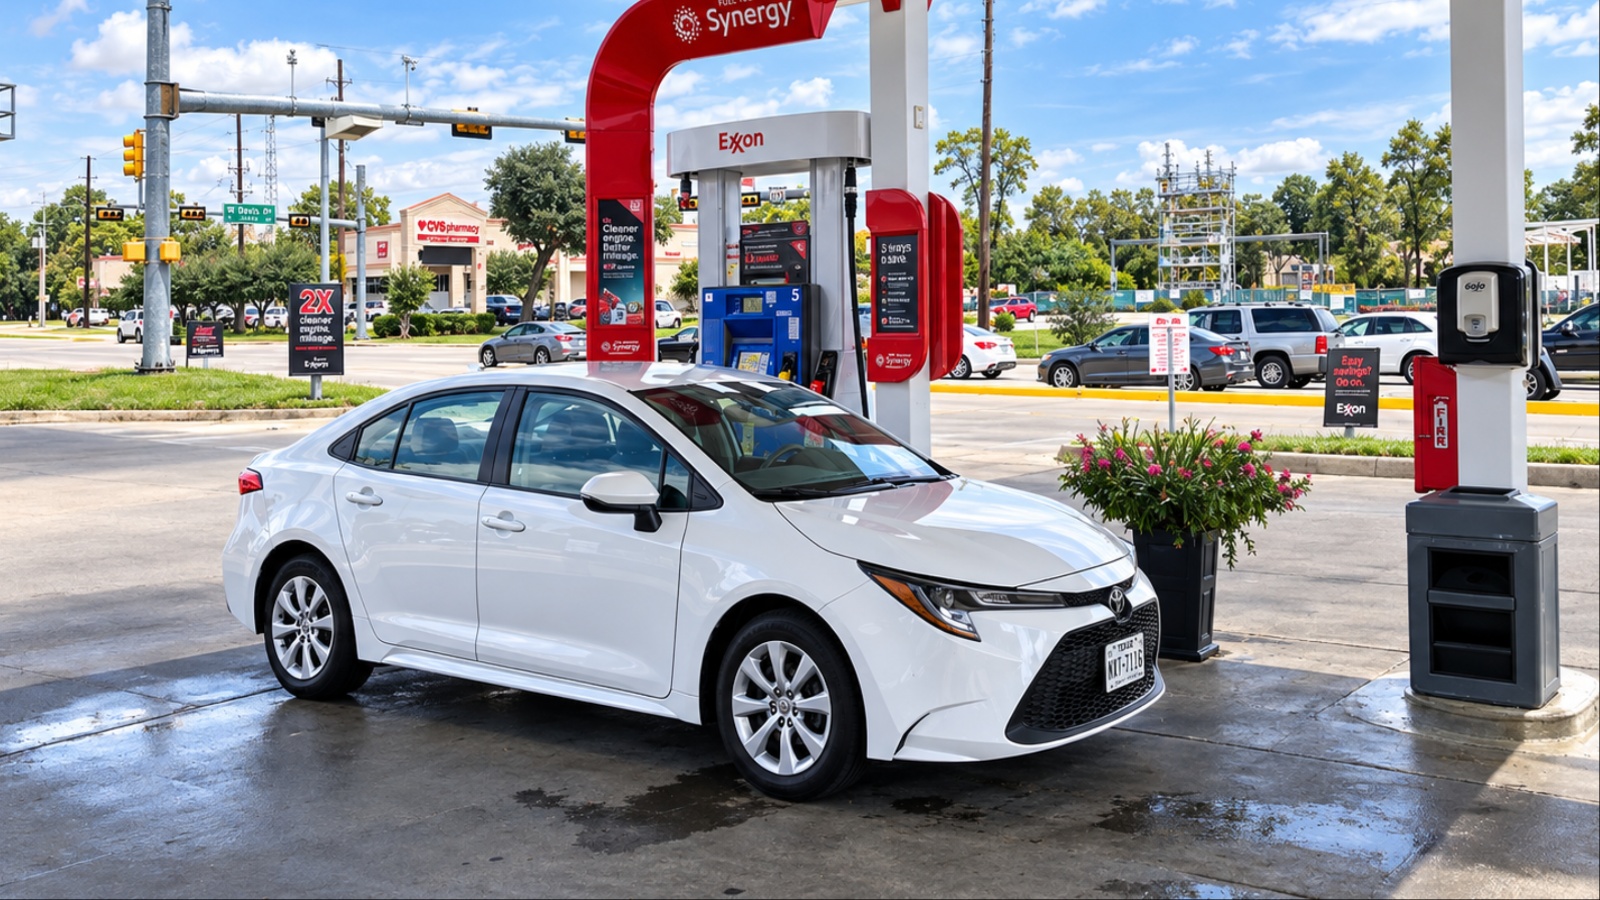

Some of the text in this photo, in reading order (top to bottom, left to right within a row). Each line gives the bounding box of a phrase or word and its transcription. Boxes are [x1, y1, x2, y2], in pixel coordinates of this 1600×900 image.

[706, 0, 793, 37] Synergy
[719, 132, 764, 154] Exxon
[427, 220, 480, 235] CVS pharmacy
[603, 224, 639, 233] Cleaner
[299, 288, 335, 315] 2X
[791, 288, 800, 302] 5
[299, 315, 333, 325] cleaner
[1336, 402, 1366, 417] Exxon
